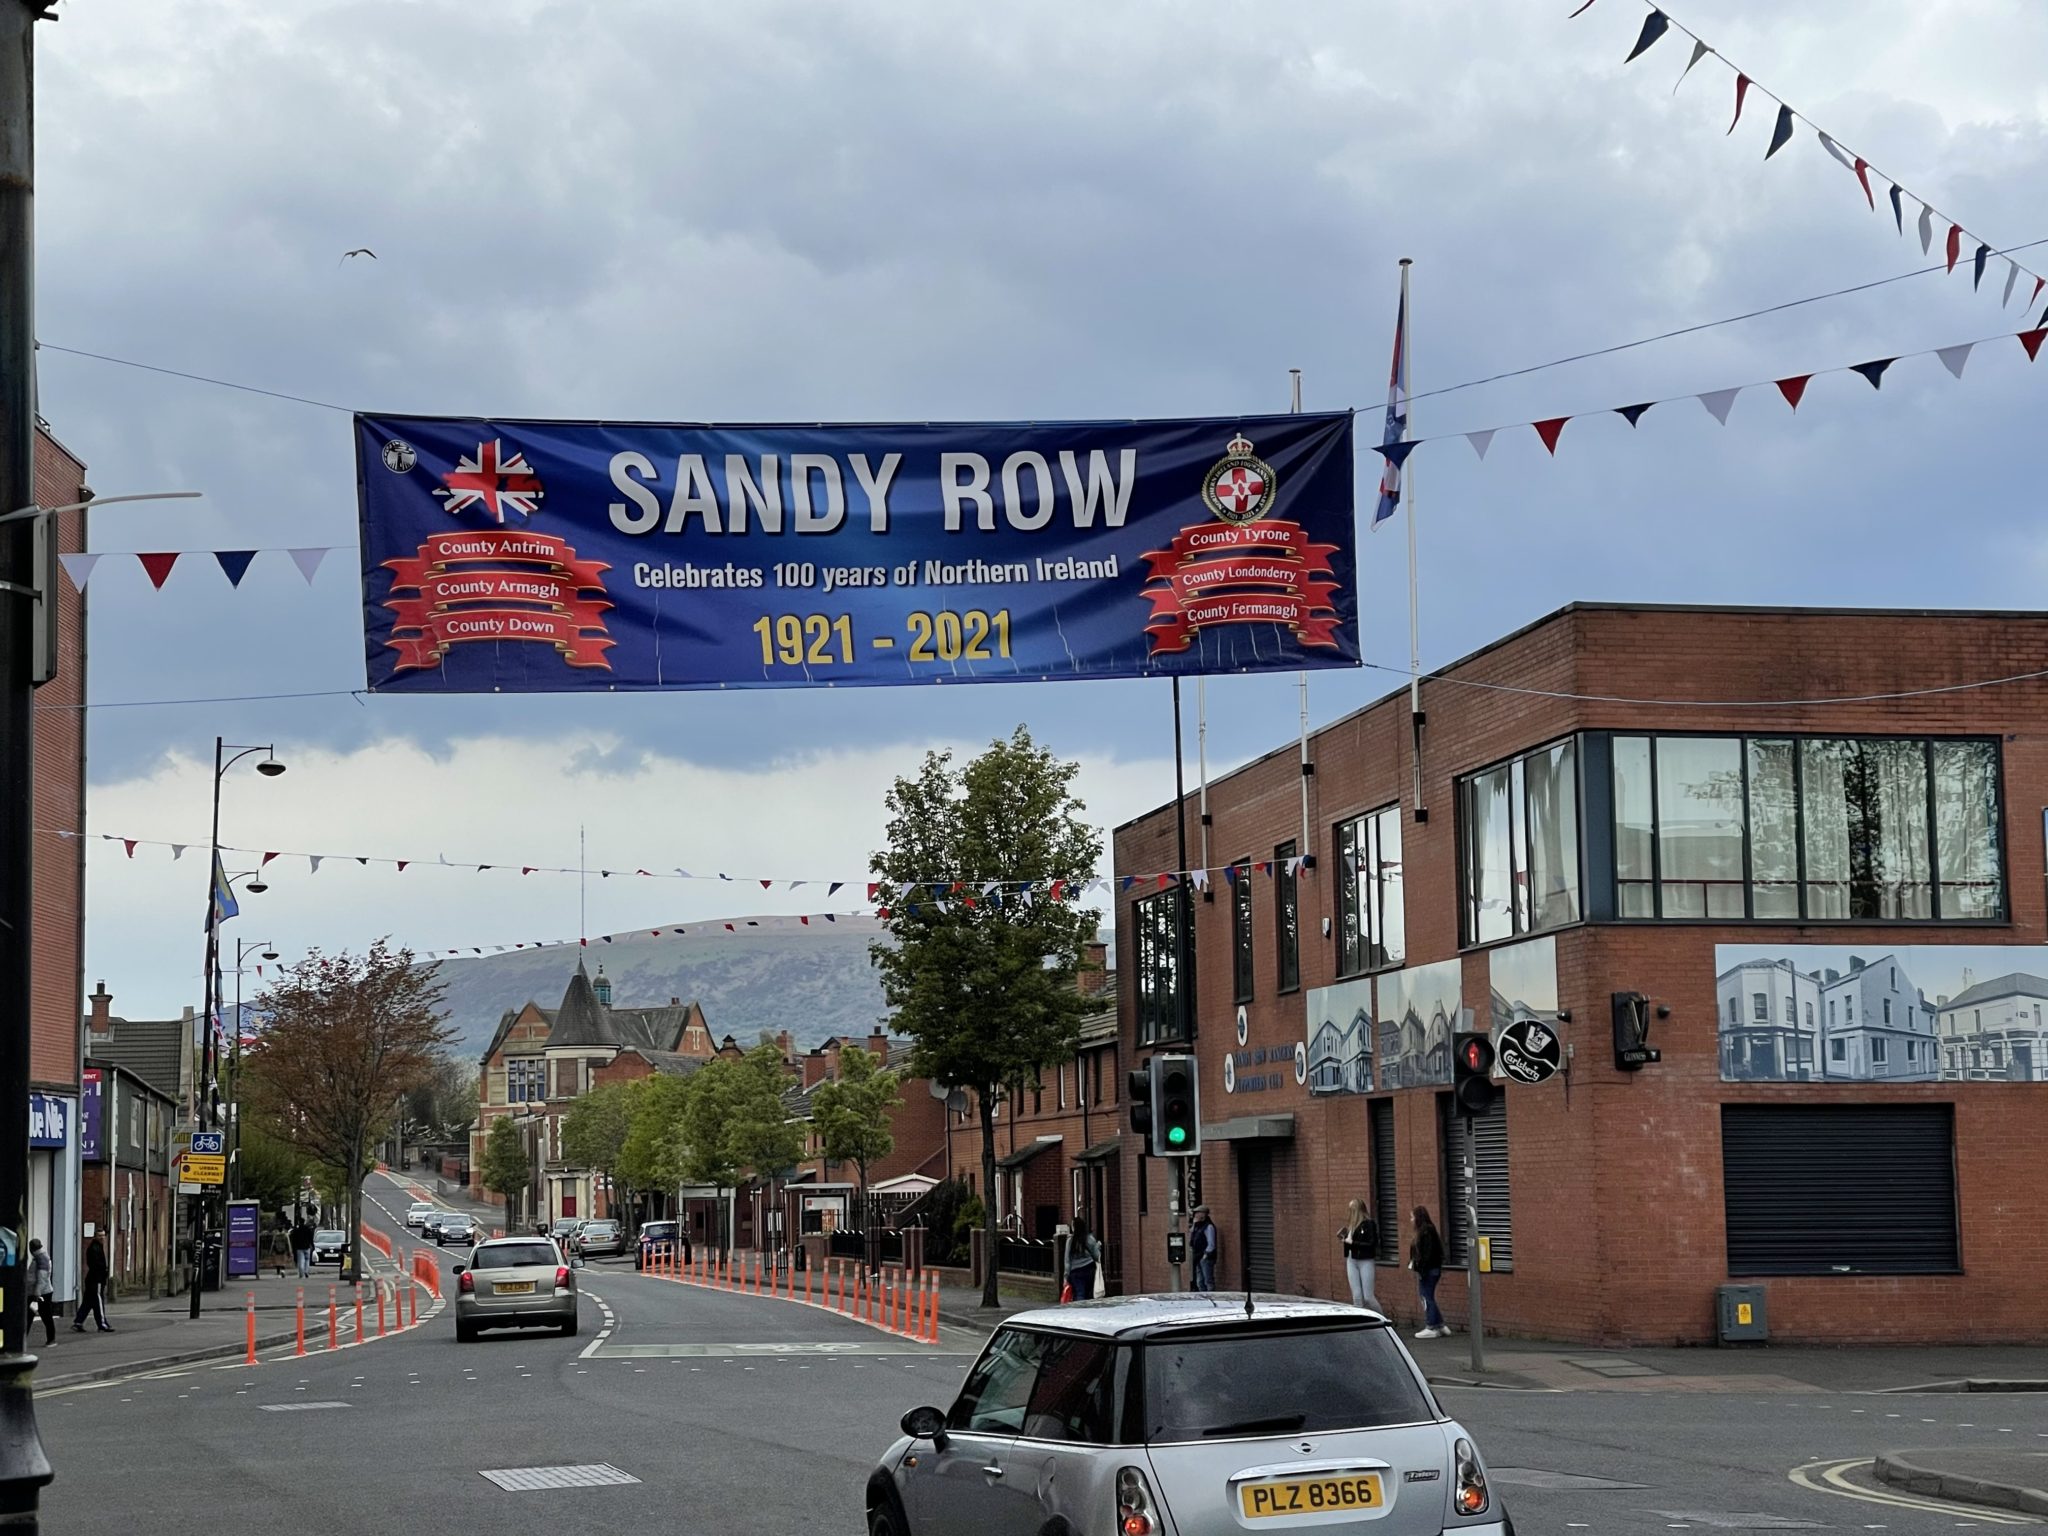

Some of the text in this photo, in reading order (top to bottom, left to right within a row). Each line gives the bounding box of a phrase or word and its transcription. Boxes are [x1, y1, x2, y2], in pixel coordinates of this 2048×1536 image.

[608, 448, 1136, 534] SANDY ROW
[439, 540, 555, 556] County Antrim
[1190, 528, 1291, 546] County Tyrone
[633, 554, 1119, 592] Celebrates 100 years of Northern Ireland
[1183, 565, 1297, 585] County Londonderry
[436, 580, 560, 599] County Armagh
[1187, 602, 1298, 622] County Fermanagh
[446, 618, 555, 634] County Down
[753, 610, 1011, 665] 1921 - 2021
[1503, 1049, 1540, 1082] Carlsberg
[29, 1101, 64, 1139] lue Nile
[1253, 1479, 1372, 1513] PLZ 8366
